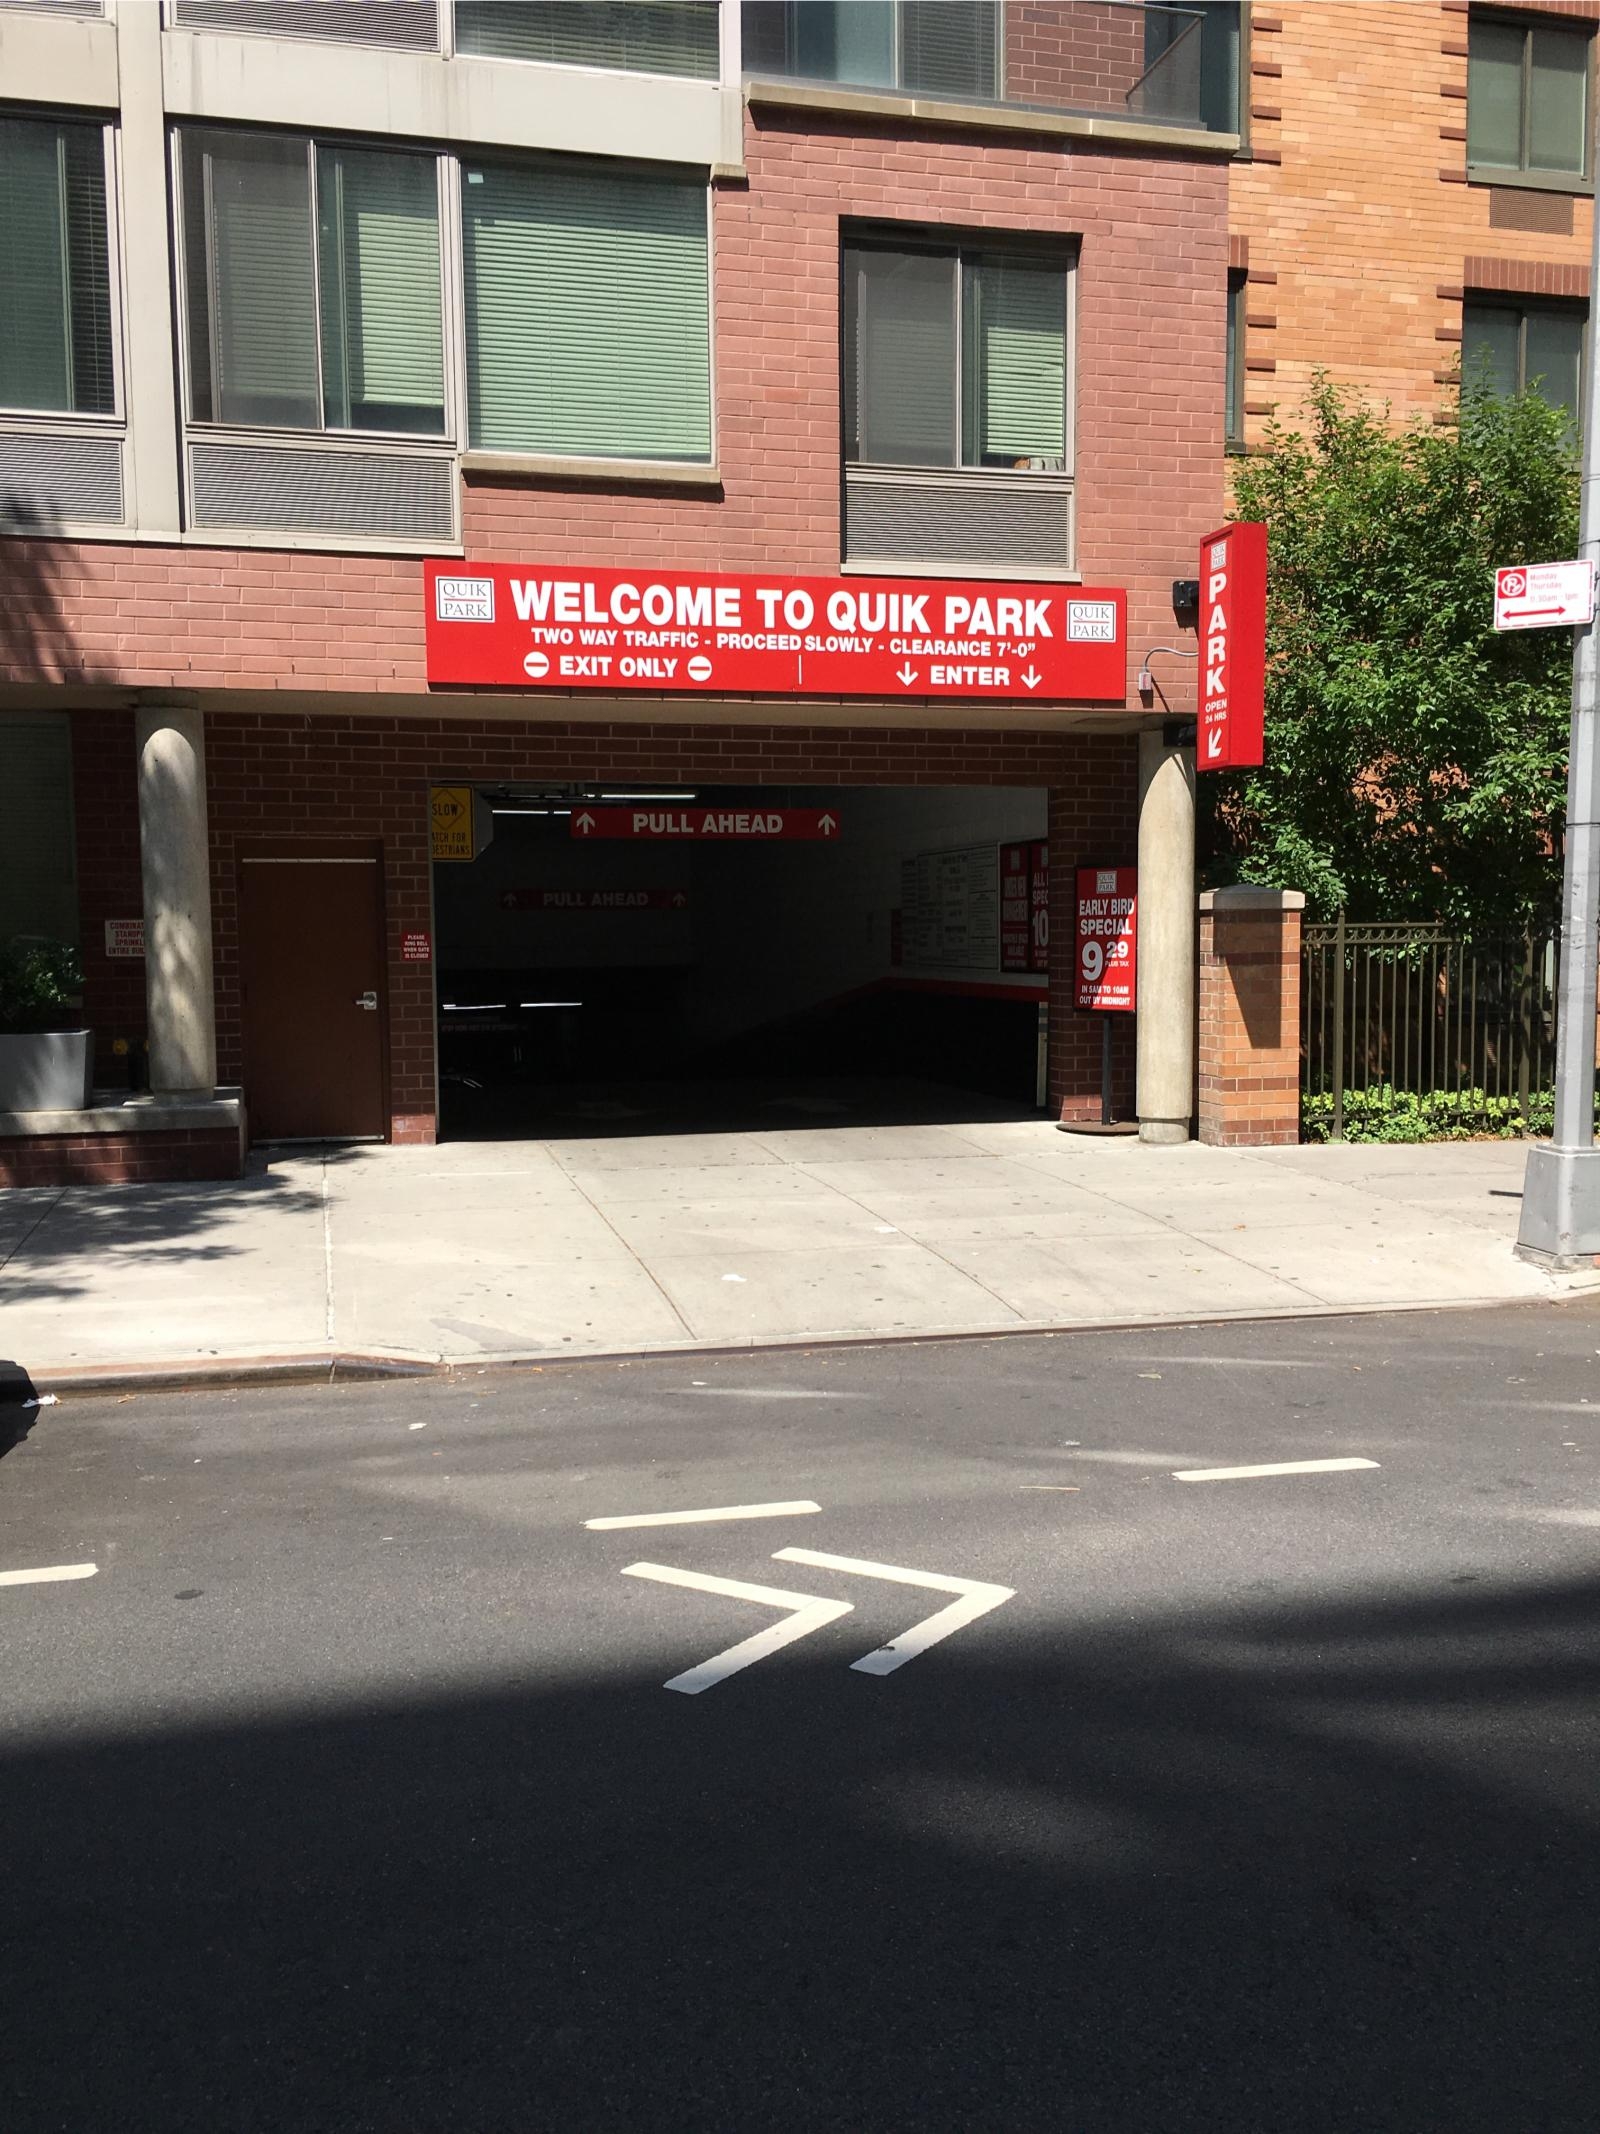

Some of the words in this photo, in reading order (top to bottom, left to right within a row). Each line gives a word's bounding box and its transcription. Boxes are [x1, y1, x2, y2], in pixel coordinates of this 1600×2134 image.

[1530, 573, 1558, 581] Monday
[443, 582, 487, 598] QUIK
[1530, 582, 1563, 591] Thursday
[443, 602, 488, 617] PARK
[509, 579, 742, 627] WELCOME
[755, 588, 814, 630] TO
[826, 590, 930, 634] QUIK
[945, 596, 1053, 638] PARK
[1072, 605, 1110, 621] QUIK
[1072, 624, 1110, 638] PARK
[1206, 572, 1227, 697] PARK
[531, 627, 574, 645] TWO
[578, 629, 619, 646] WAY
[623, 630, 699, 648] TRAFFIC
[717, 633, 801, 651] PROCEED
[804, 636, 873, 653] SLOWLY
[889, 638, 991, 656] CLEARANCE
[560, 655, 613, 676] EXIT
[619, 657, 678, 678] ONLY
[930, 665, 1010, 686] ENTER
[1205, 698, 1227, 713] OPEN
[1205, 714, 1213, 725] 24
[1214, 711, 1227, 722] HRS
[432, 803, 458, 817] SLOW
[632, 813, 694, 834] PULL
[701, 813, 784, 834] AHEAD
[432, 831, 449, 843] ATCH
[452, 832, 466, 843] FOR
[432, 844, 471, 856] DESTRIANS
[1033, 872, 1046, 887] ALL
[543, 892, 587, 907] PULL
[591, 892, 650, 907] AHEAD
[1032, 890, 1049, 905] SPEC
[1079, 899, 1109, 916] EARLY
[1111, 898, 1135, 915] BIRD
[1080, 918, 1133, 935] SPECIAL
[1082, 941, 1103, 981] 9
[1106, 941, 1129, 958] 29
[1082, 985, 1088, 993] IN
[1103, 985, 1111, 993] TO
[1113, 986, 1129, 994] 10AM
[1080, 996, 1091, 1005] OUT
[1093, 996, 1101, 1005] BY
[1102, 997, 1131, 1006] MIDNIGHT
